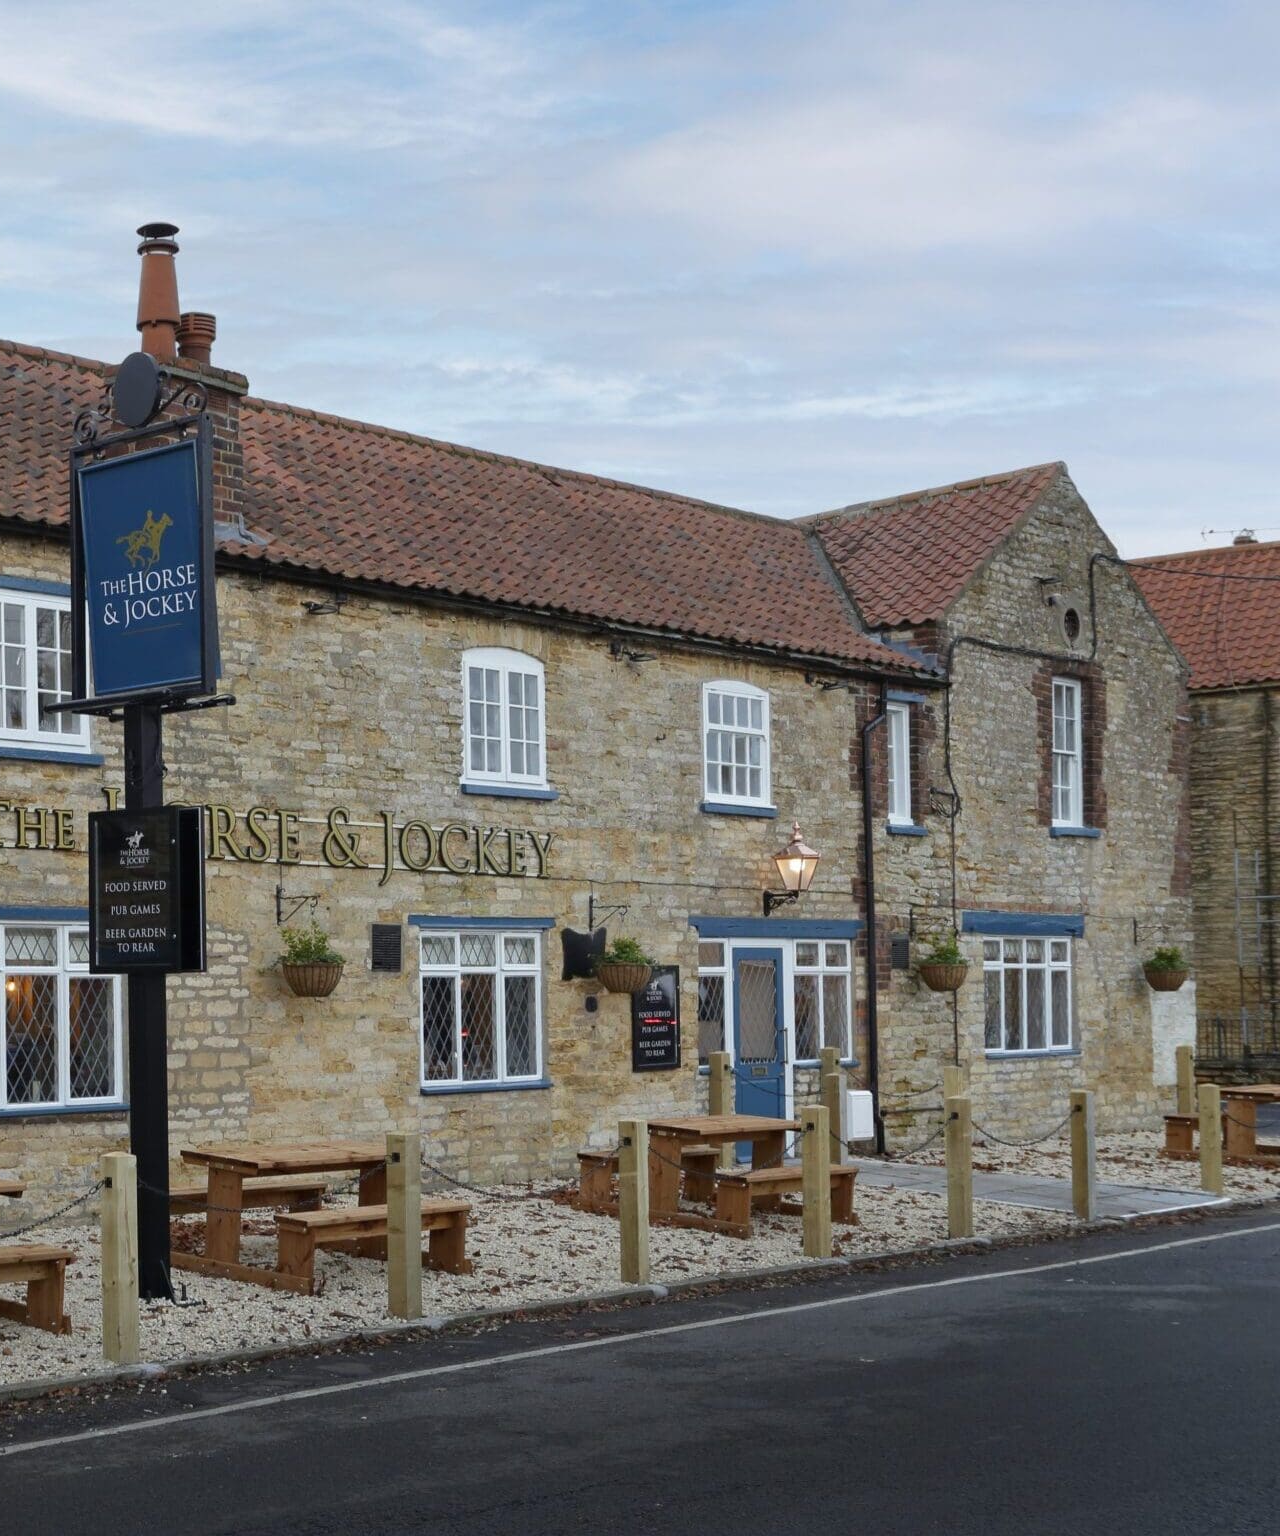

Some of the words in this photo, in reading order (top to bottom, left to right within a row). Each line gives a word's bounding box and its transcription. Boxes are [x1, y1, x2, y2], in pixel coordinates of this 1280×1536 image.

[100, 579, 127, 596] THE
[128, 564, 197, 596] HORSE
[103, 603, 120, 626] &
[124, 590, 197, 628] JOCKEY
[102, 787, 301, 864] RSE
[323, 806, 370, 868] &
[379, 810, 559, 887] JOCKEY
[128, 848, 150, 856] HORSE
[120, 857, 126, 865] &
[126, 856, 150, 866] JOCKEY
[105, 882, 130, 893] FOOD
[132, 880, 166, 891] SERVED
[111, 906, 127, 916] PUB
[130, 904, 160, 915] GAMES
[105, 928, 126, 939] BEER
[128, 928, 166, 938] GARDEN
[117, 942, 130, 953] TO
[132, 942, 155, 952] REAR
